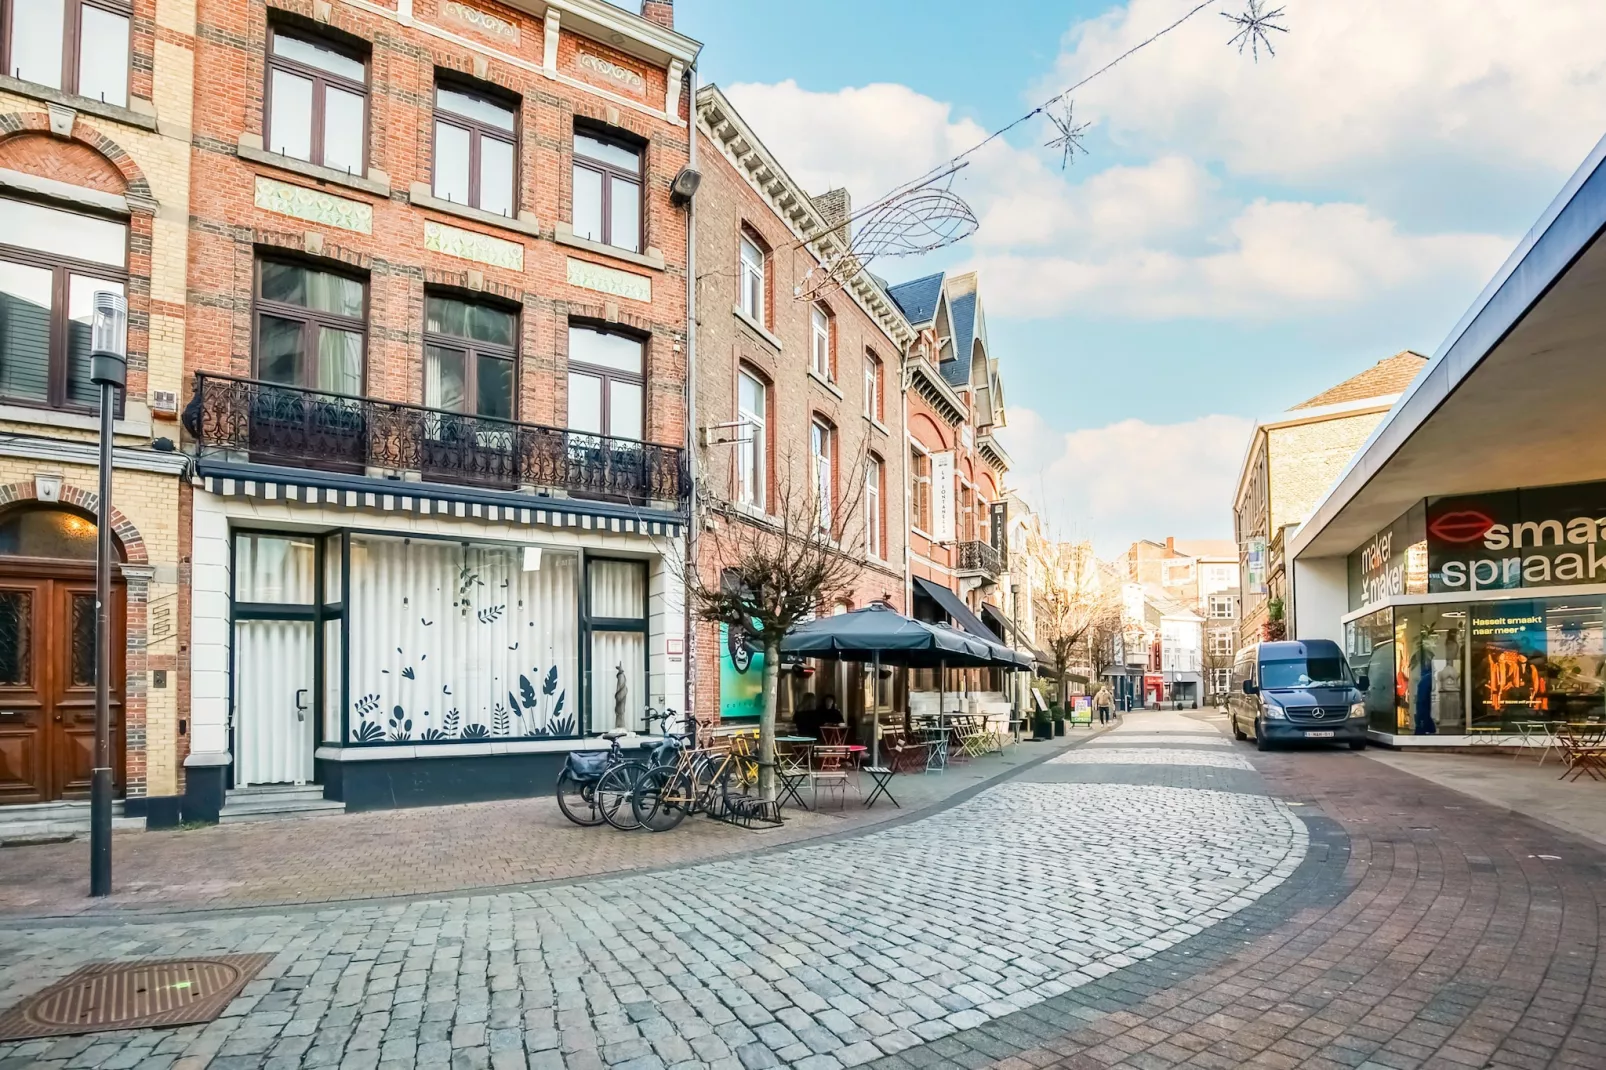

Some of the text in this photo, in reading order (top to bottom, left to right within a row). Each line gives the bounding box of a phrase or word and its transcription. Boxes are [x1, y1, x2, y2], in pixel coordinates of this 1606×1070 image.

[1483, 517, 1606, 550] sma
[1362, 531, 1392, 575] maker
[1370, 563, 1404, 604] maker
[1472, 616, 1542, 626] Hasselt smaakt
